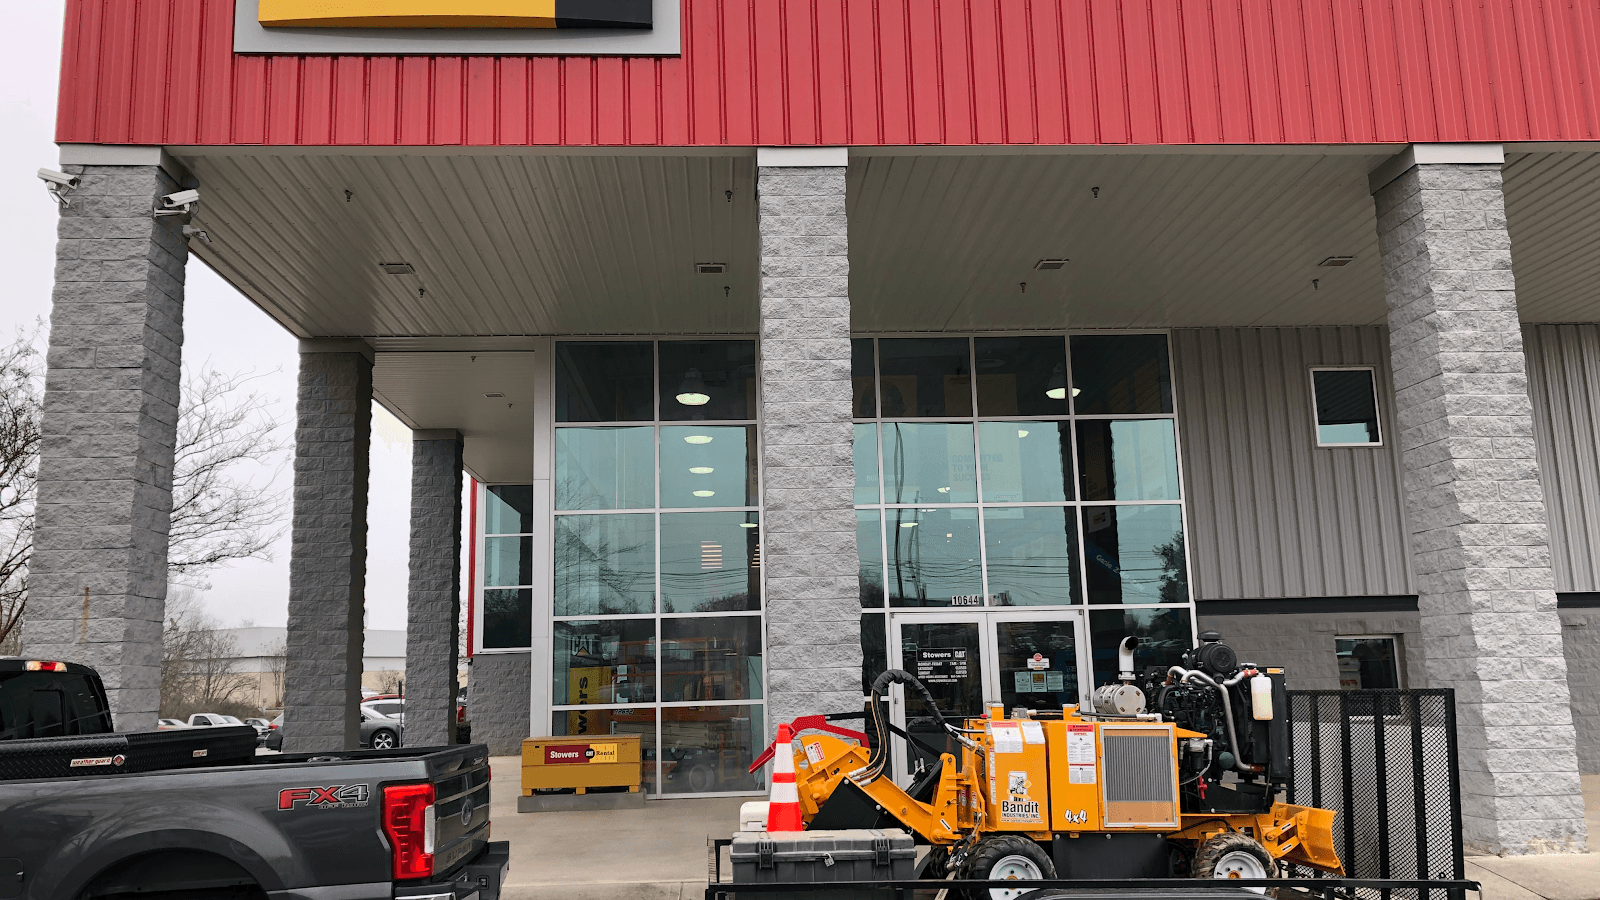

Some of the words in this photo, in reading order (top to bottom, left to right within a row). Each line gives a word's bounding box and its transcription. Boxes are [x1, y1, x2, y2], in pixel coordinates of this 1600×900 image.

[951, 454, 1003, 463] COMITTED
[952, 464, 963, 472] TO
[965, 463, 989, 472] YOR
[952, 473, 991, 482] SUCCSS
[952, 596, 979, 605] 10644
[550, 751, 579, 759] Stowers
[277, 783, 370, 811] FX4
[1002, 801, 1039, 813] Bandit
[1065, 809, 1088, 824] 4x4
